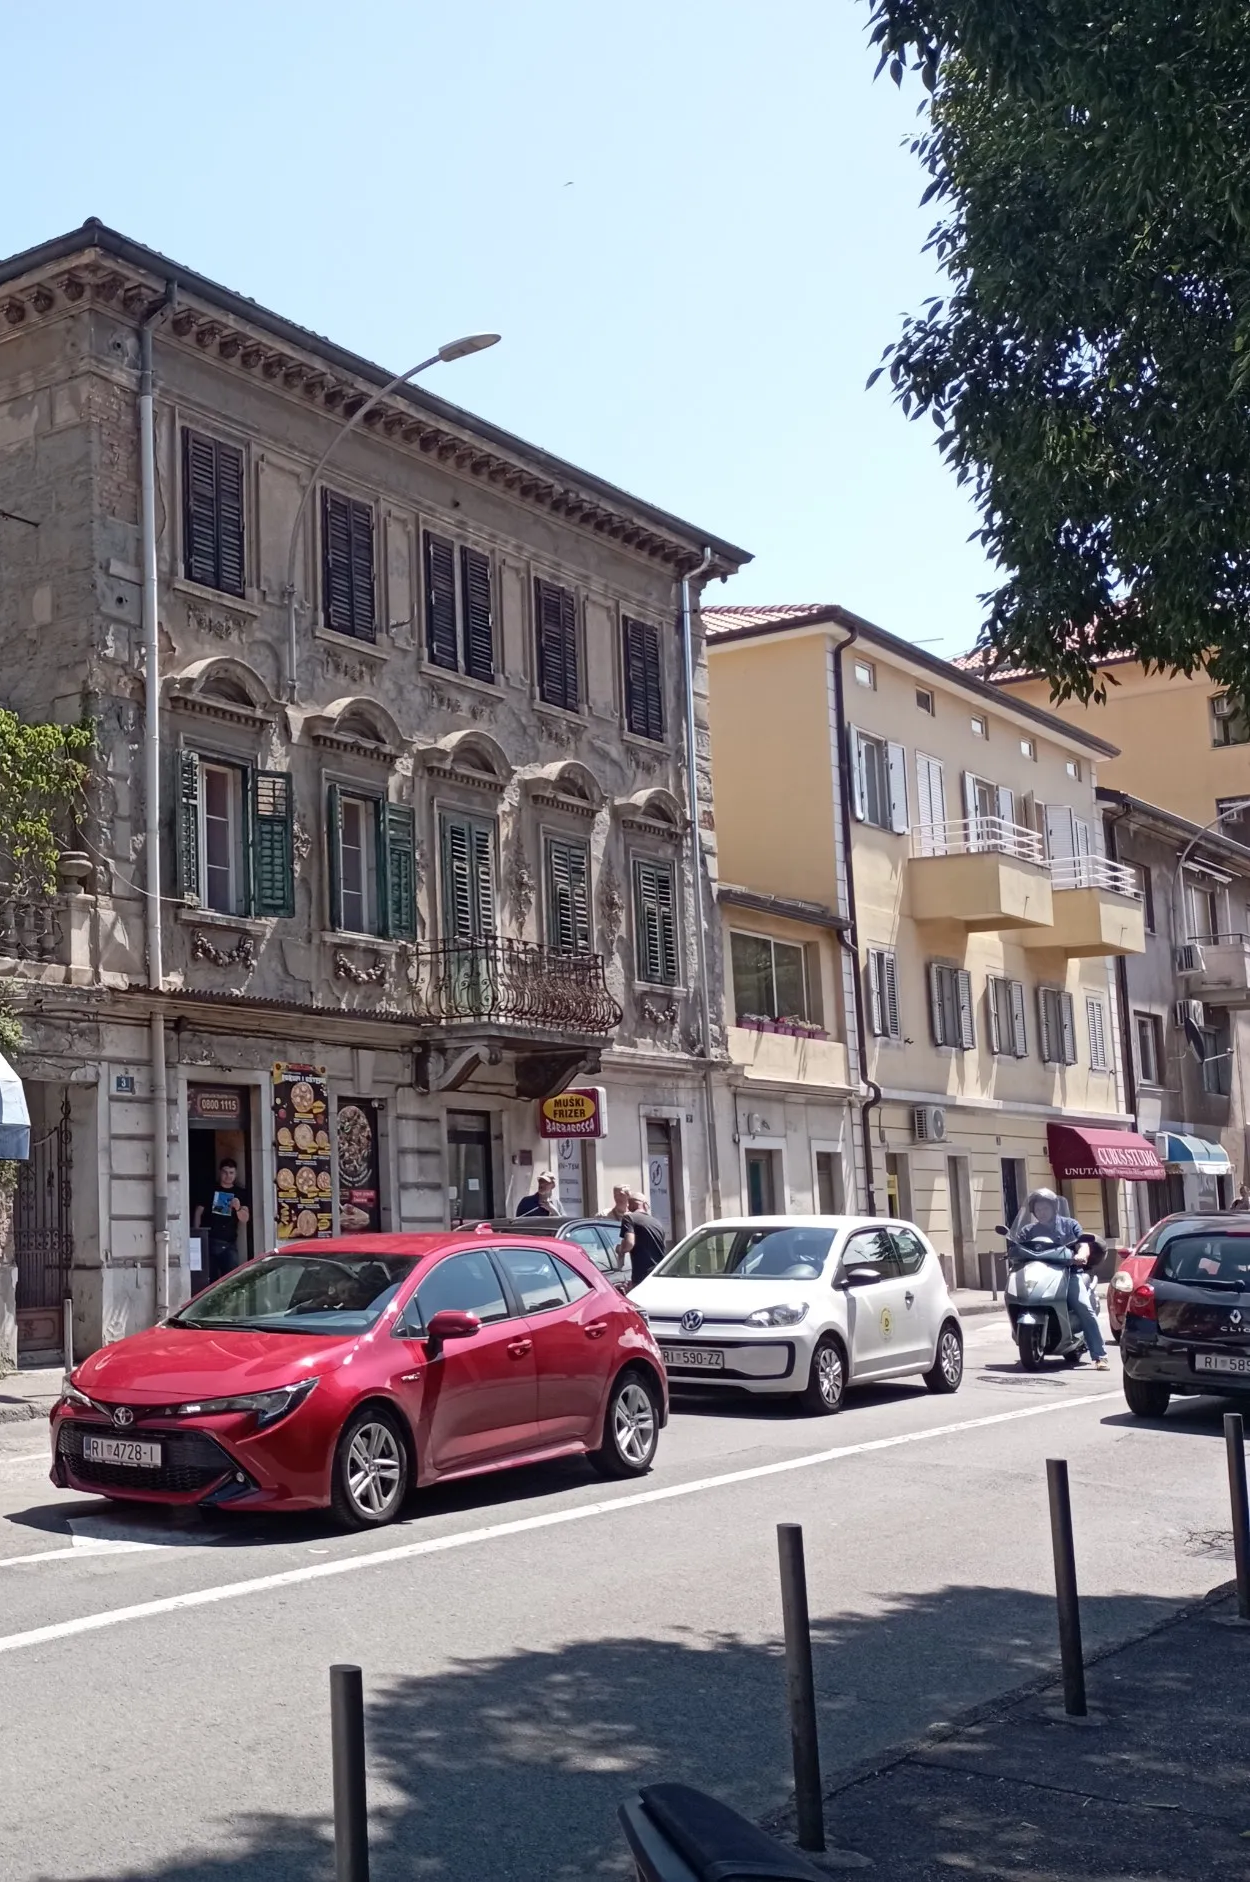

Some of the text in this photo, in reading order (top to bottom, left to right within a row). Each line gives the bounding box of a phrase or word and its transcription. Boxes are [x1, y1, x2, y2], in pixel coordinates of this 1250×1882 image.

[121, 1077, 126, 1087] 3
[201, 1099, 237, 1111] 0800 1115
[554, 1096, 584, 1108] MUŠKI
[553, 1109, 586, 1118] FRIZER
[546, 1118, 595, 1133] BARBAROSSA
[1097, 1147, 1159, 1167] CUBUS STUDIO
[663, 1351, 721, 1365] RI 590-ZZ
[1204, 1356, 1218, 1369] RI
[91, 1441, 104, 1457] RI
